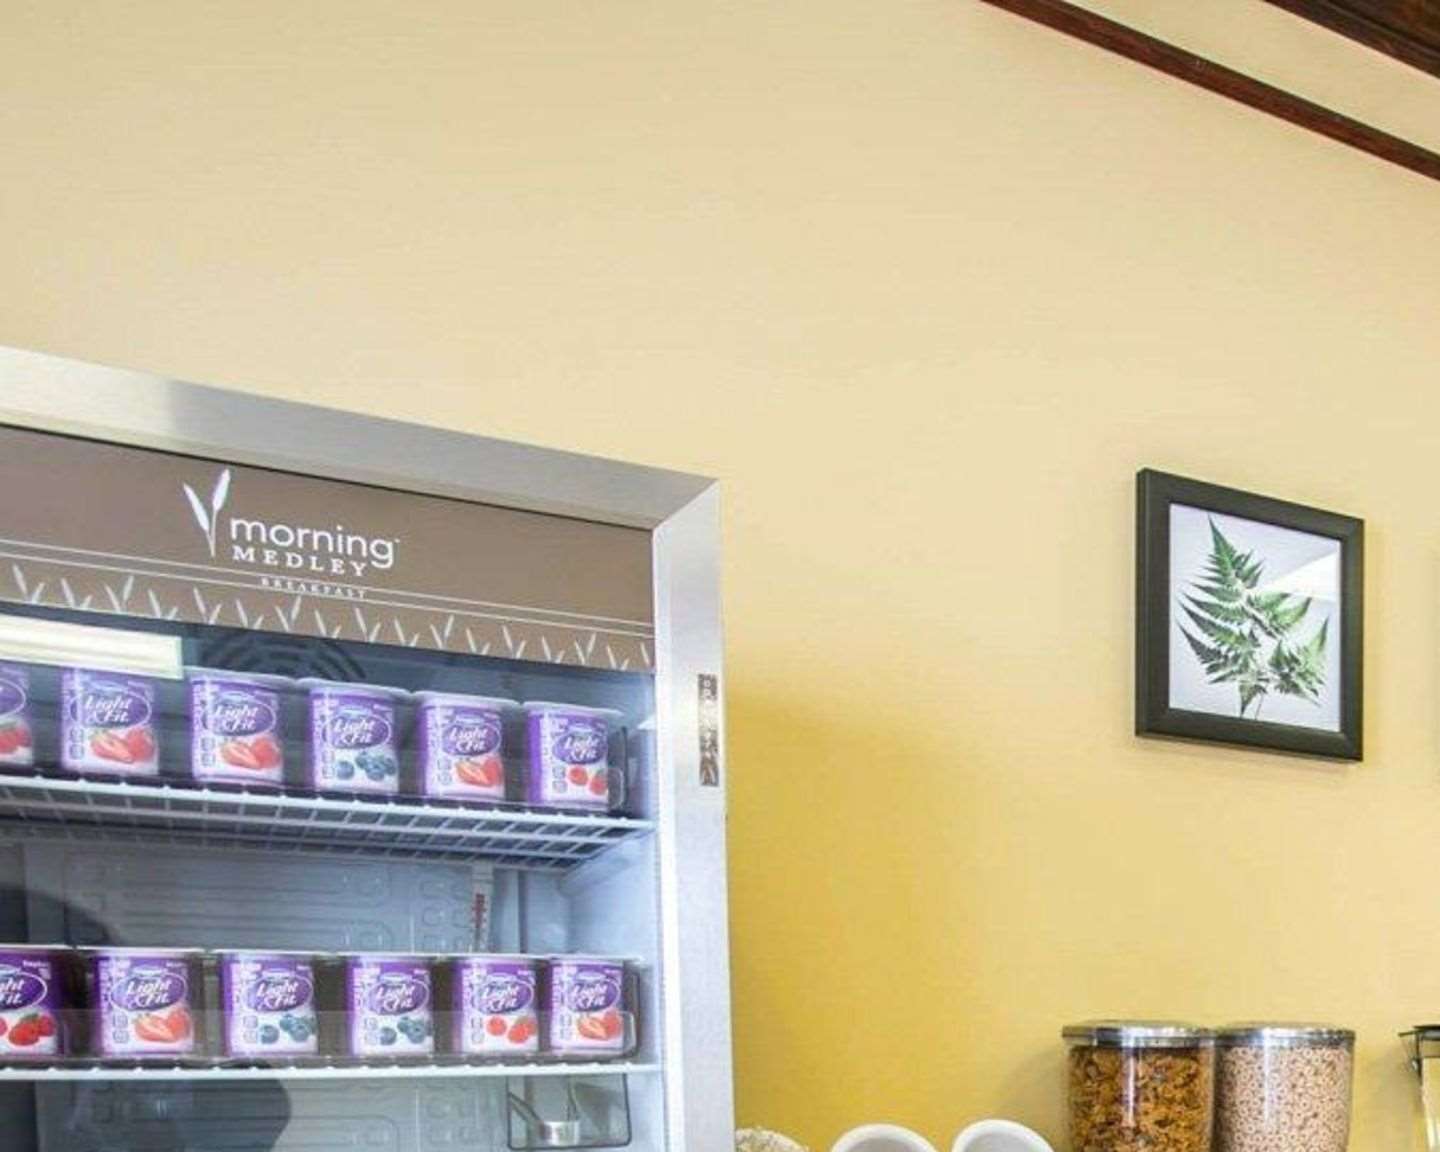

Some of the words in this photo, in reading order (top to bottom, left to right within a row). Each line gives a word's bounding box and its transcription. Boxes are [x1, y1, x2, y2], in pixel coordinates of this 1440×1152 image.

[230, 517, 394, 569] morning
[231, 545, 367, 577] MEDLEY
[84, 694, 134, 713] Light
[214, 701, 259, 720] Light
[332, 712, 377, 734] Light
[451, 727, 489, 744] Light
[564, 731, 600, 750] Light
[127, 976, 172, 997] Light
[257, 977, 299, 998] Light
[376, 981, 416, 1002] Light
[483, 981, 520, 1001] Light
[573, 979, 608, 999] Light
